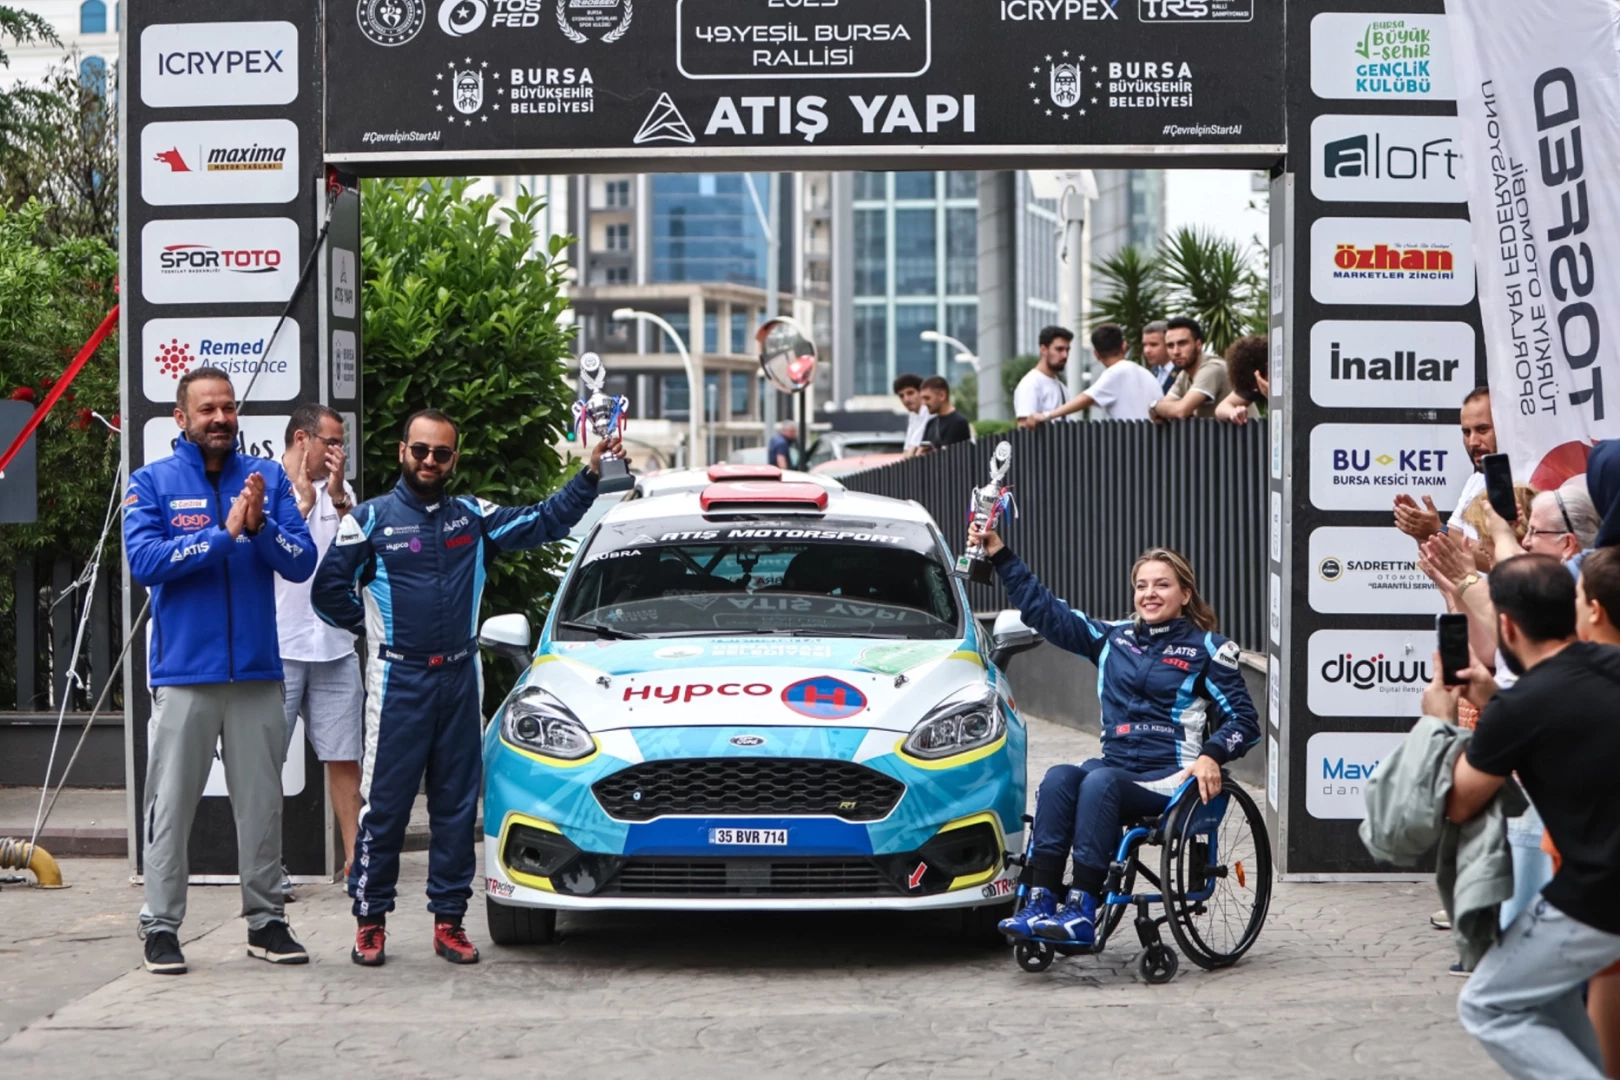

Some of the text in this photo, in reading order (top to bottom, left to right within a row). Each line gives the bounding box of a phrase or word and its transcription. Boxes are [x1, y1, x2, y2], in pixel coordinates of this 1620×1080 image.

[1001, 0, 1119, 20] ICRYPEX
[491, 12, 540, 28] FED
[696, 22, 911, 45] 49.YEŞİL BURSA
[159, 49, 283, 76] ICRYPEX
[753, 46, 854, 66] RALLİSİ
[510, 68, 594, 85] BURSA
[1109, 62, 1192, 79] BURSA
[1356, 60, 1430, 77] GENÇLİK
[511, 86, 593, 101] BÜYÜKŞEHİR
[1109, 79, 1193, 95] BÜYÜKŞEHİR
[1356, 77, 1431, 93] KULÜBÜ
[511, 99, 594, 114] BELEDİYESİ
[1109, 93, 1193, 108] BELEDİYESİ
[704, 94, 975, 142] ATIŞ YAPI
[207, 143, 286, 163] maxima
[1324, 133, 1458, 179] aloft
[1333, 270, 1454, 280] MARKETLER ZİNCİRİ
[199, 338, 264, 355] Remed
[202, 358, 287, 373] Assistance
[1333, 449, 1448, 472] BU KET
[1333, 473, 1446, 486] BURSA KESİCİ TAKIM
[660, 529, 905, 543] ATIŞ MOTORSPORT
[623, 683, 773, 704] Hypco
[718, 830, 785, 844] 35 BVR 714
